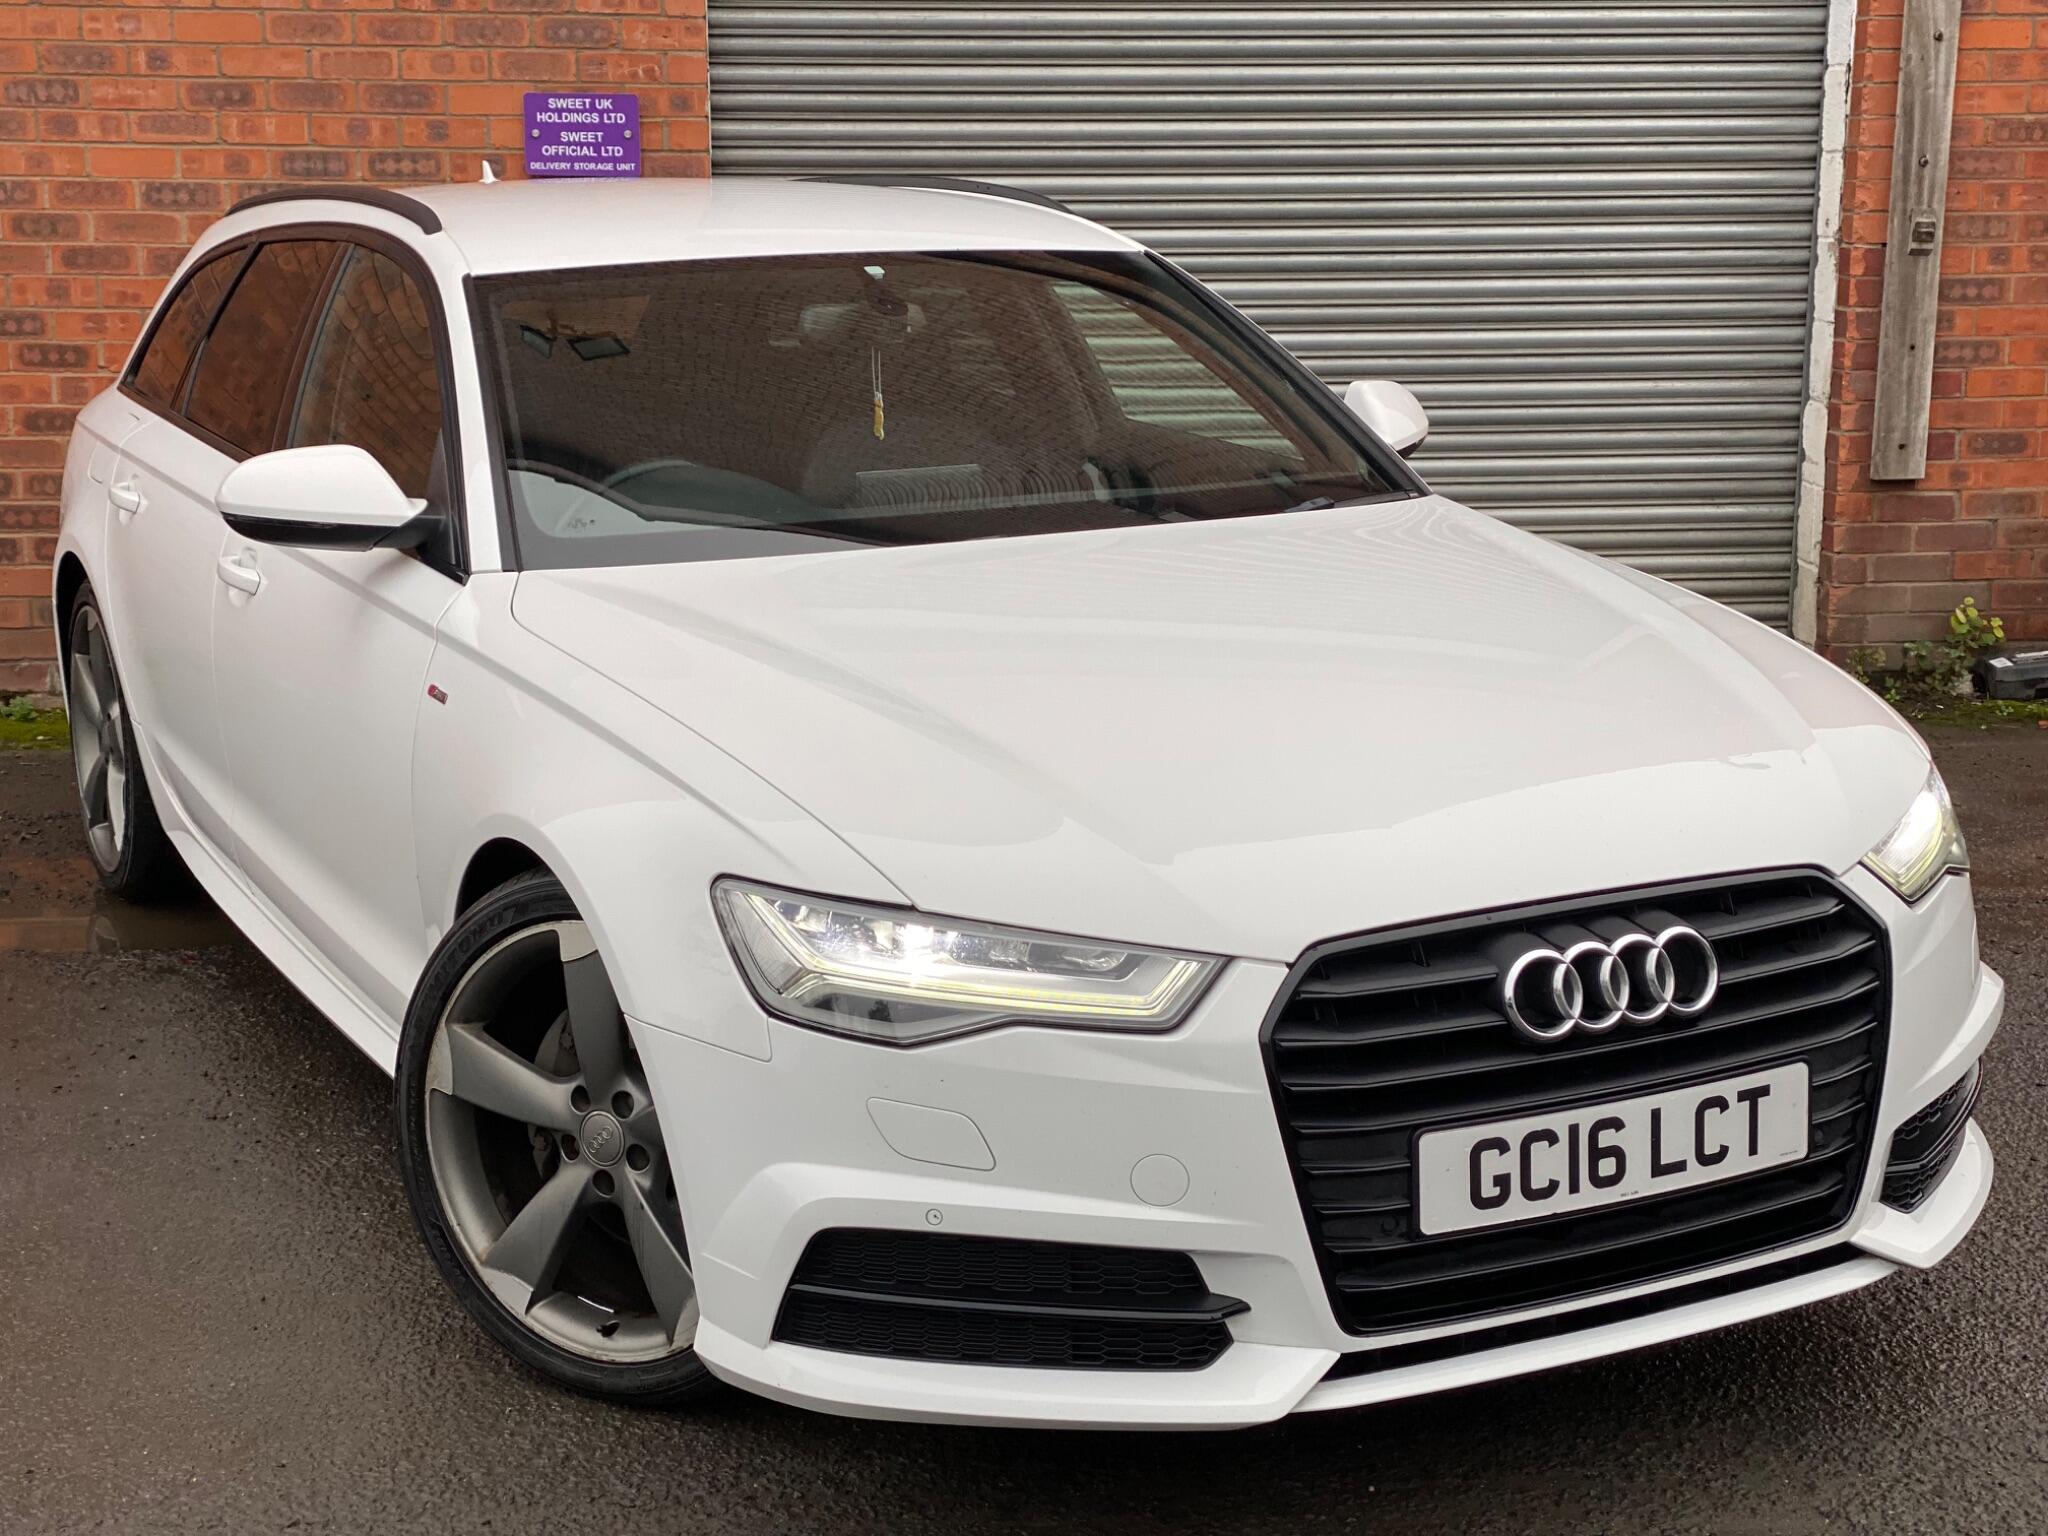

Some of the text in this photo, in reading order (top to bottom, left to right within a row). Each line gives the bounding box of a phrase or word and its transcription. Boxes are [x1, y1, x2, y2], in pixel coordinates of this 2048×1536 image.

[548, 98, 613, 109] SWEET UK
[536, 112, 625, 123] HOLDINGS LTD
[560, 131, 603, 142] SWEET
[542, 145, 623, 156] OFFICIAL LTD
[530, 162, 636, 171] DELIVERY STORAGE UNIT
[1469, 1084, 1771, 1210] GC16 LCT
